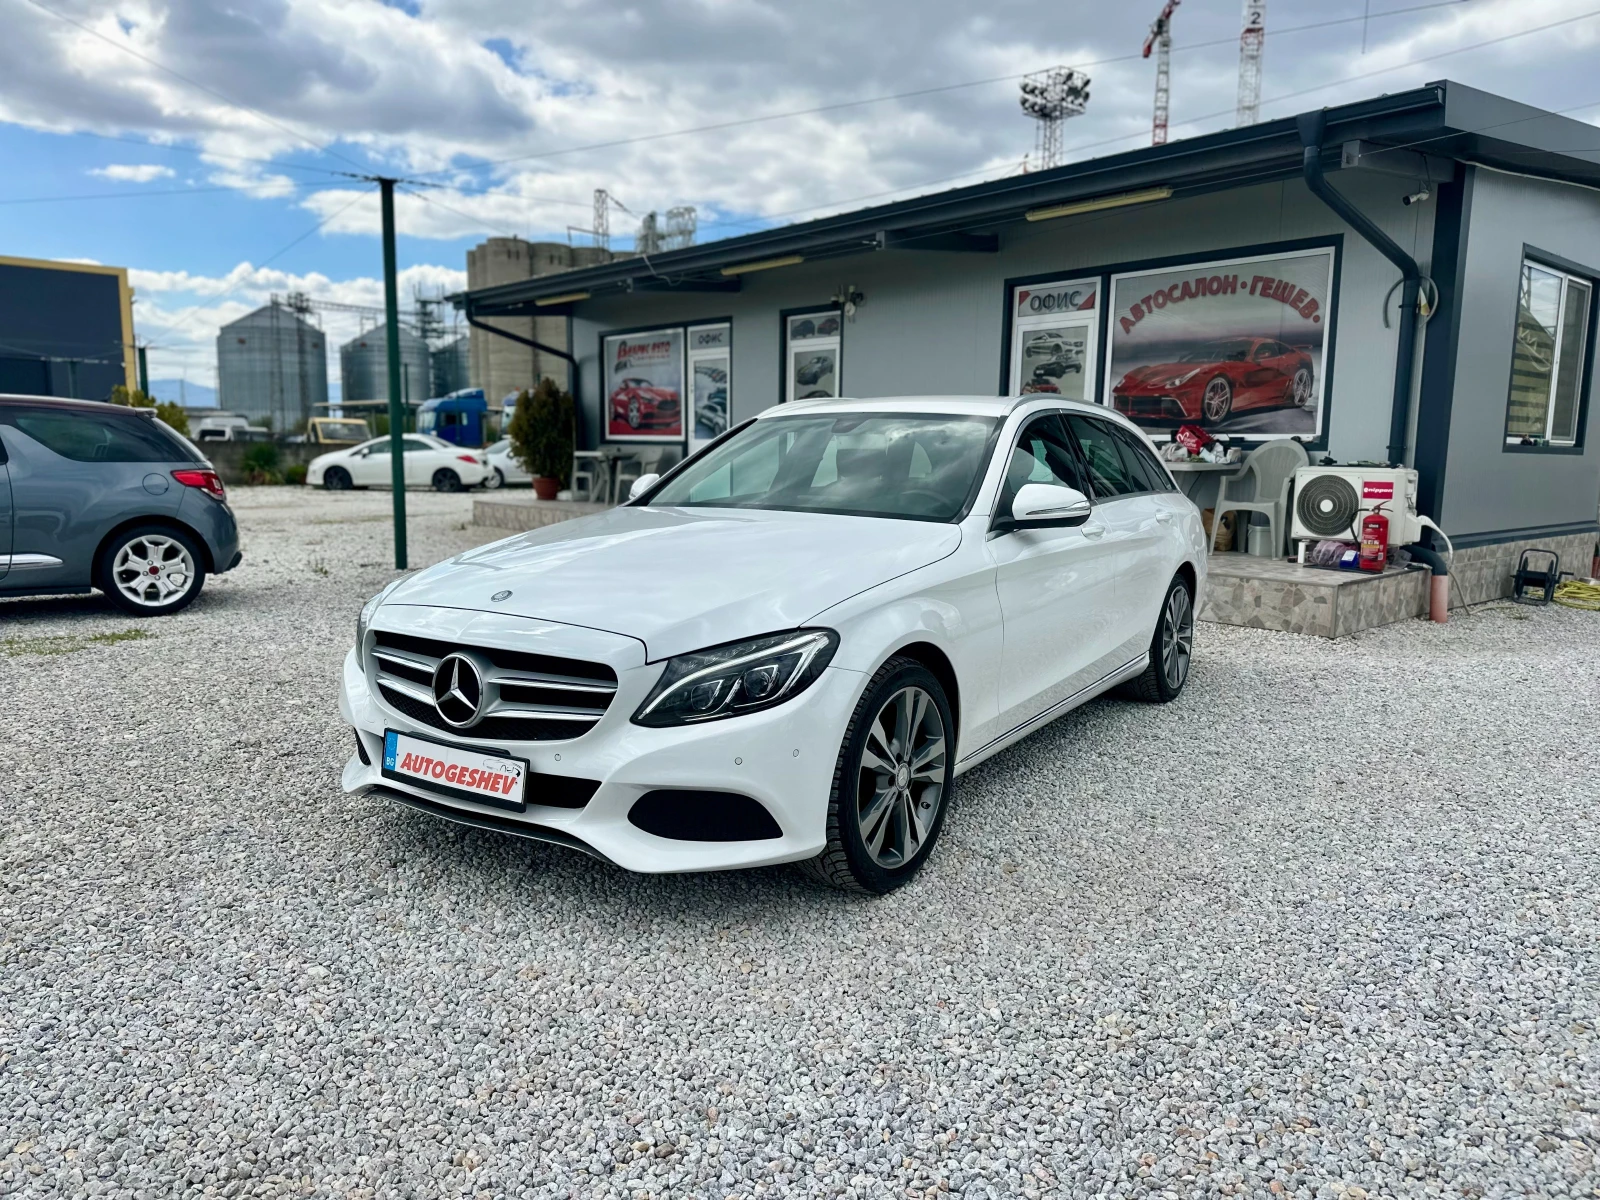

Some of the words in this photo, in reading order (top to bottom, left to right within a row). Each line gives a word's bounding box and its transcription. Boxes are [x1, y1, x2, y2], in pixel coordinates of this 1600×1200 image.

[1250, 7, 1261, 25] 2
[1029, 291, 1082, 312] ОФИС
[1119, 274, 1239, 334] АВТОСАЛОН
[1249, 275, 1321, 319] ГЕШЕВ
[697, 334, 723, 345] ОФИС
[386, 756, 395, 766] BG
[399, 752, 518, 795] AUTOGESHEV
